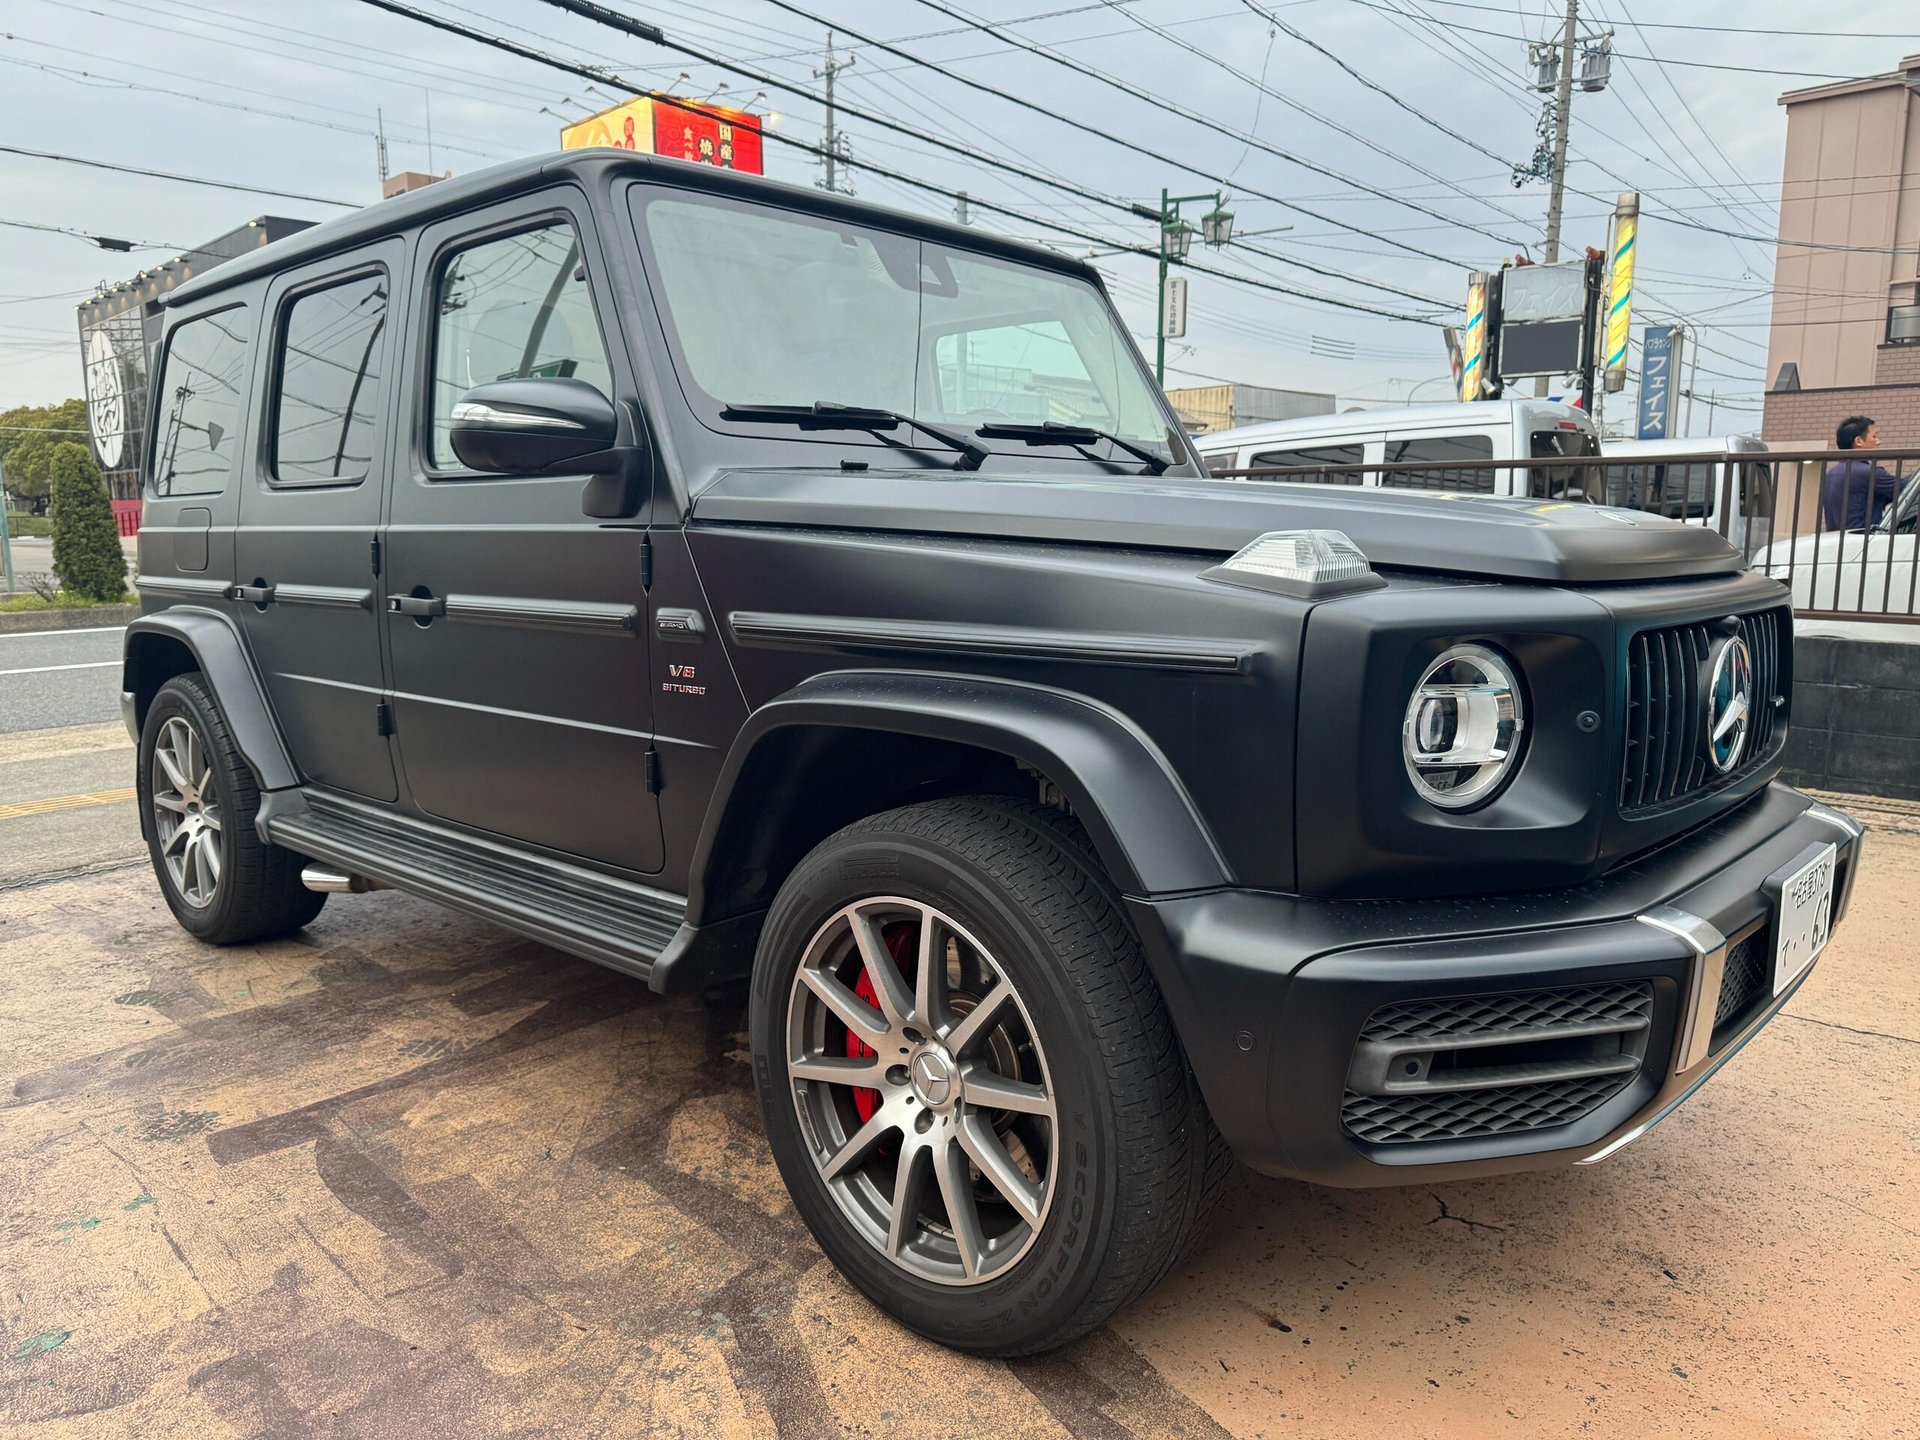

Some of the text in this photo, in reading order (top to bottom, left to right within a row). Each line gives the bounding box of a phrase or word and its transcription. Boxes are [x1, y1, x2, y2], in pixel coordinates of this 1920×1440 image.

[1643, 356, 1667, 431] フェイス
[662, 682, 706, 695] BITURBO
